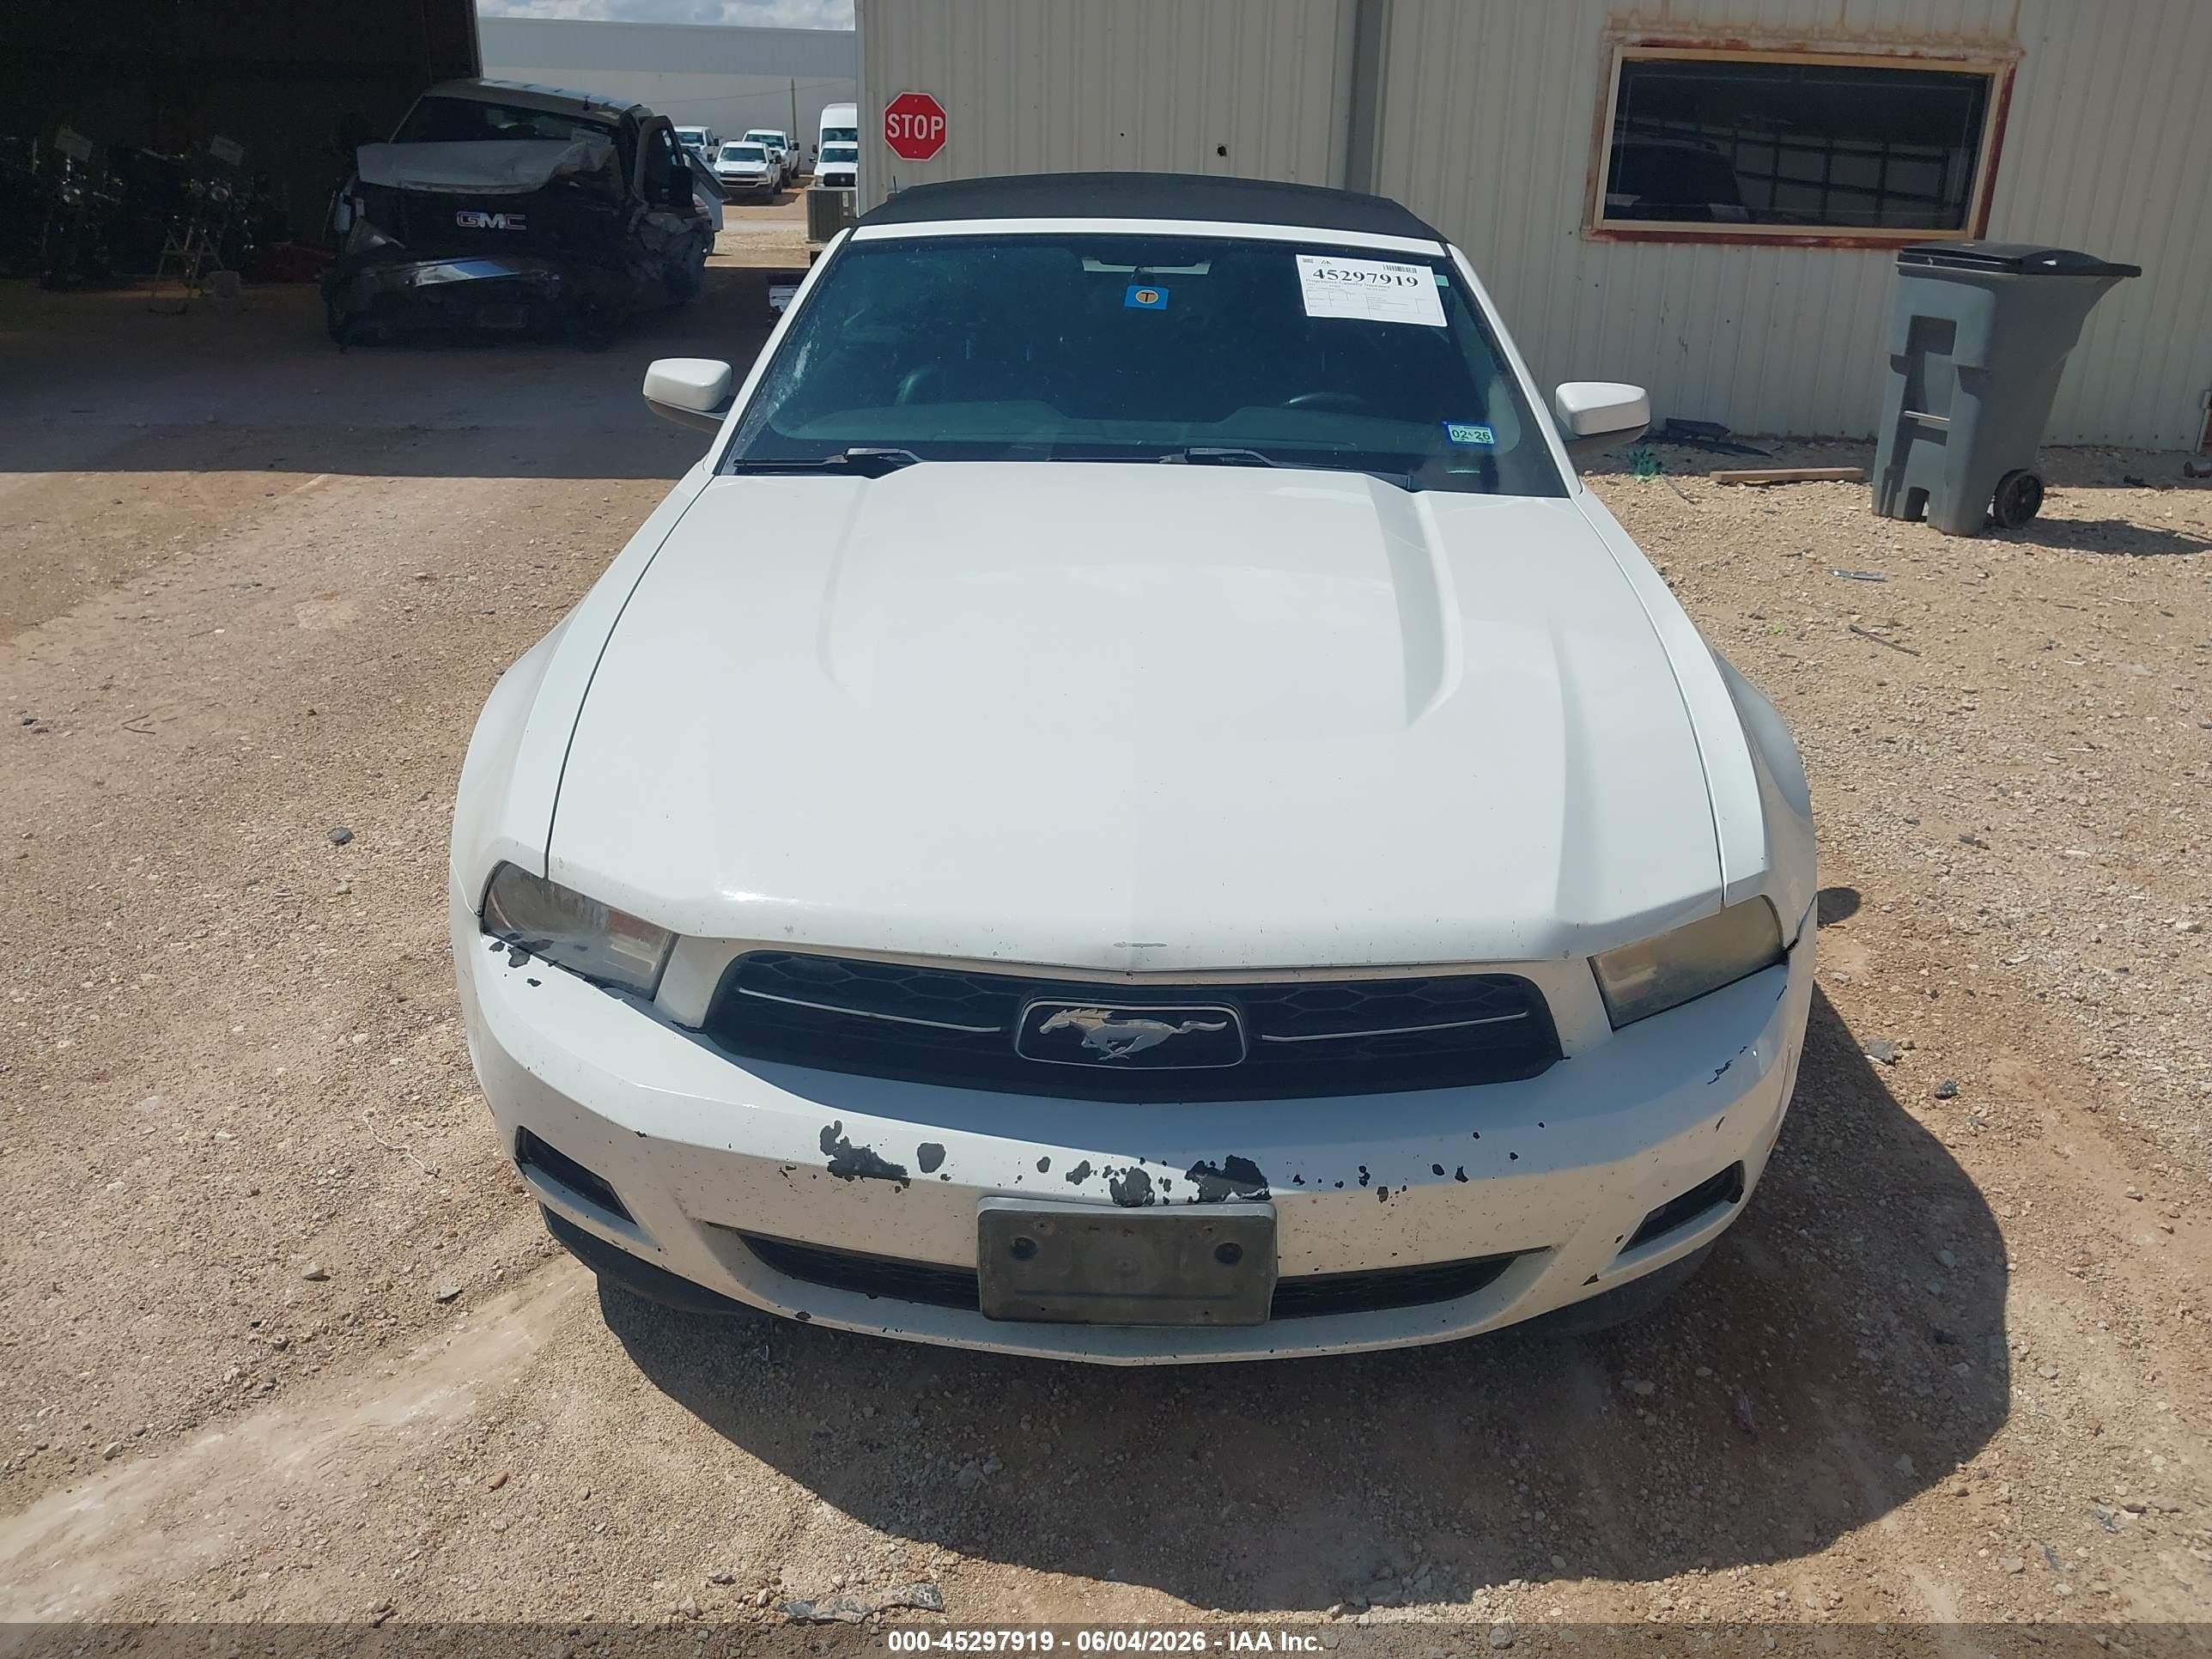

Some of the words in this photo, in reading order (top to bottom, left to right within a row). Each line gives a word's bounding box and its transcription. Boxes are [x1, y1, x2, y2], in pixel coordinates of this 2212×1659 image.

[887, 113, 944, 140] STOP
[456, 210, 526, 230] GMC
[1312, 269, 1419, 288] 45297919
[1140, 292, 1155, 302] T
